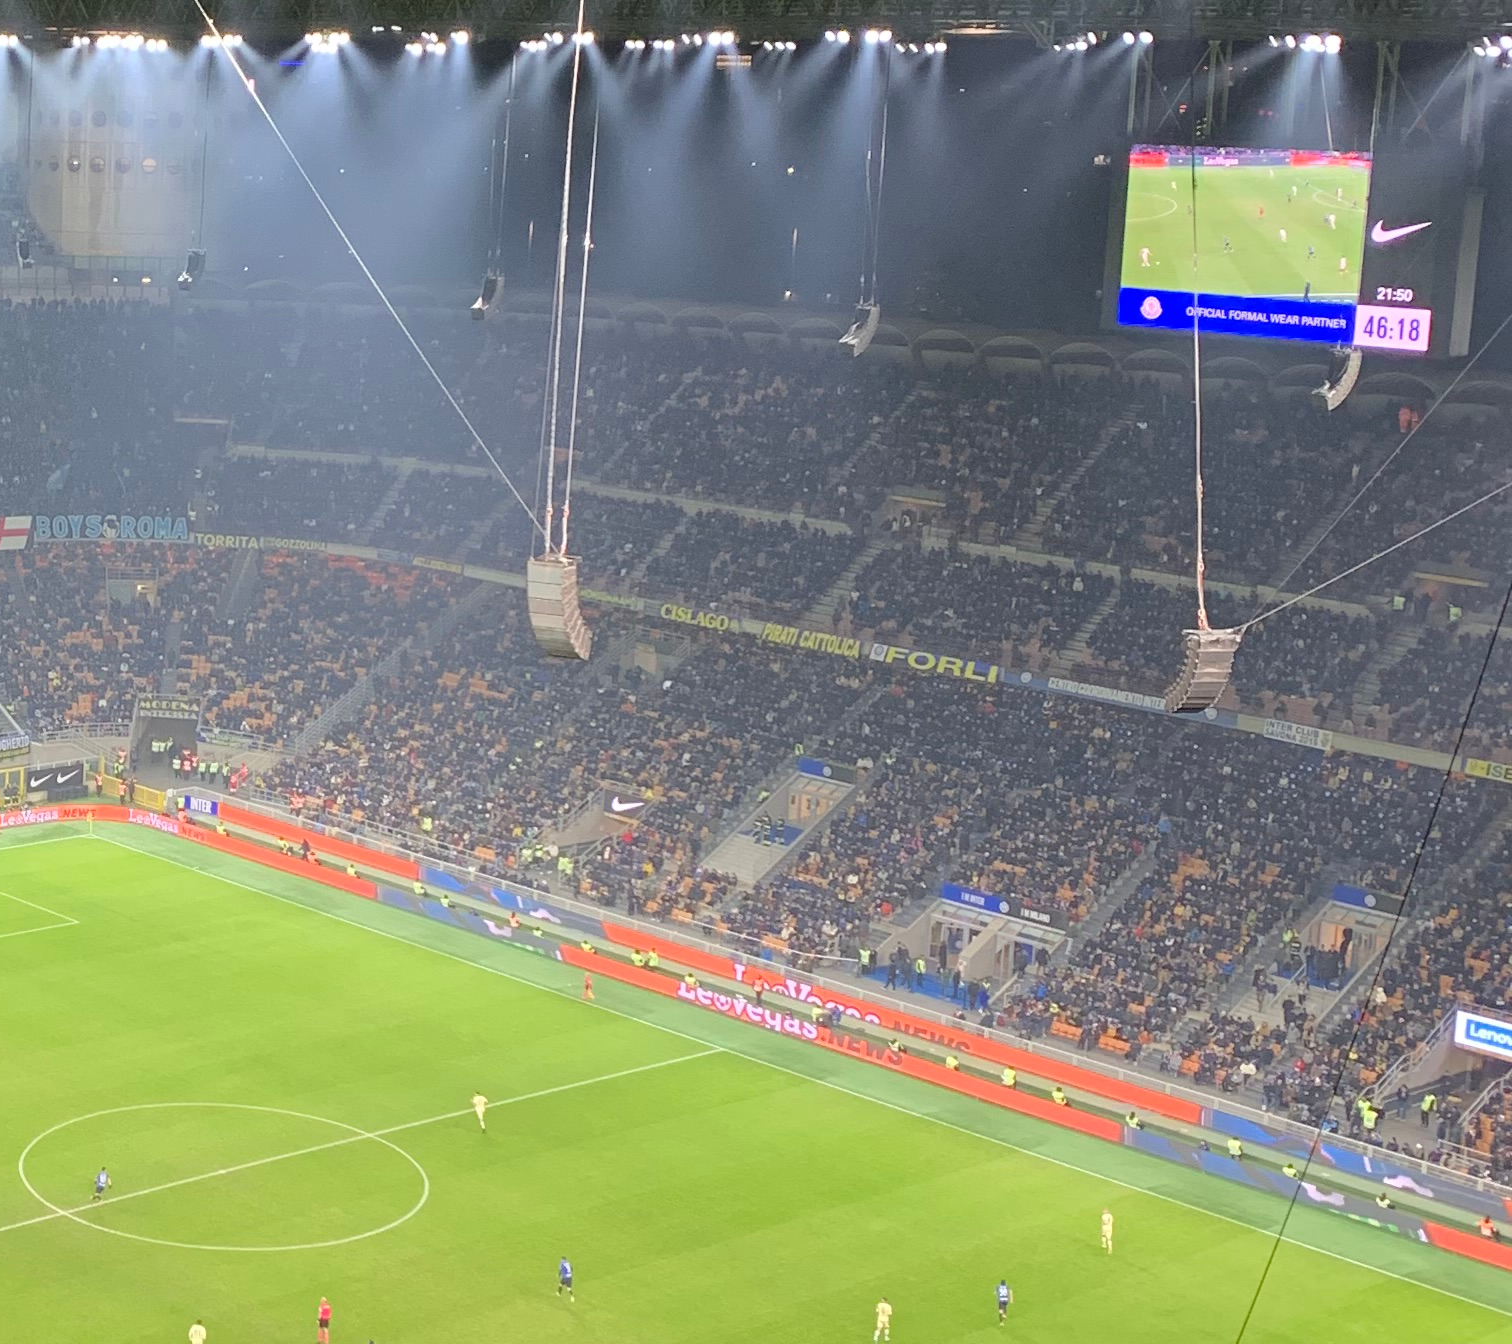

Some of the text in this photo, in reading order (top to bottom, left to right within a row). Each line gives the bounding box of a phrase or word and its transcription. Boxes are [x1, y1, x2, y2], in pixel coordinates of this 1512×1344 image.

[1376, 287, 1413, 302] 21:50
[1186, 306, 1346, 329] OFFICIAL FORMAL WEAR PARTNER
[1363, 314, 1421, 342] 46:18
[34, 515, 188, 540] BOYS ROMA
[195, 533, 258, 549] TORRITA
[660, 603, 729, 631] CISLAGO
[762, 623, 860, 659] PIRATI CATTOLICA
[884, 646, 999, 684] FORLI
[139, 699, 200, 712] MODENA
[1266, 720, 1320, 738] INTER CLUB
[190, 796, 211, 814] INTER
[0, 808, 97, 828] LeoVegas NEWS
[128, 807, 179, 834] LeoVegas
